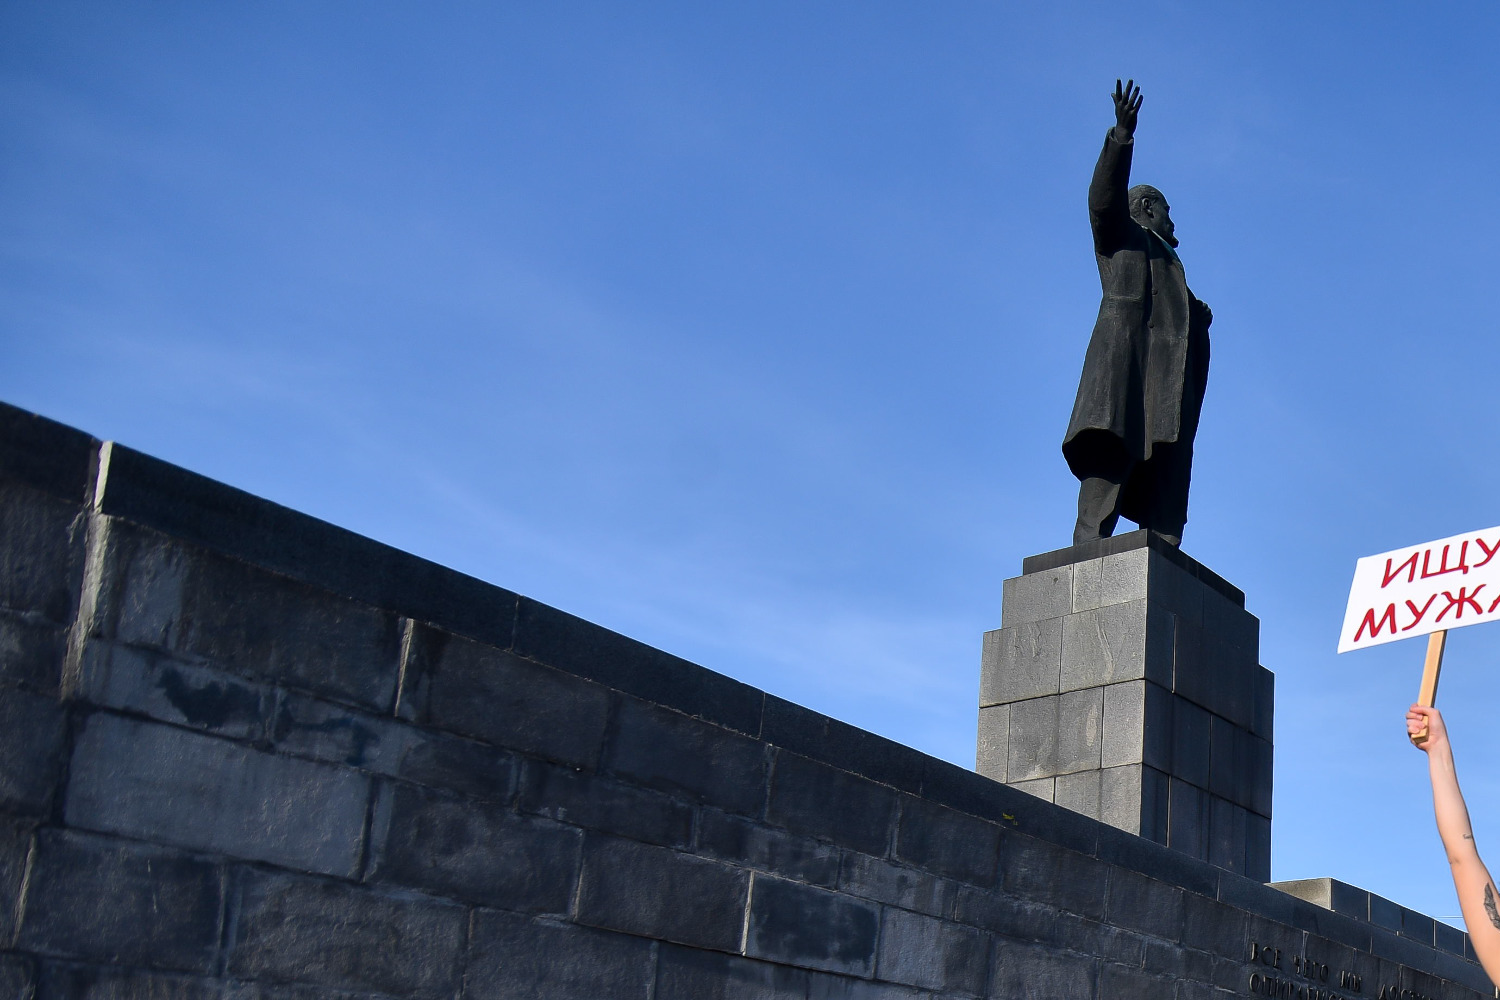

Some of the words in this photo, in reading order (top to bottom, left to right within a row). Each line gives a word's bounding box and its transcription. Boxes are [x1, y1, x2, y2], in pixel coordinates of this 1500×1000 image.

[1251, 941, 1281, 969] ВСЕ
[1293, 954, 1329, 982] ЧЕГО
[1340, 970, 1362, 993] МЫ
